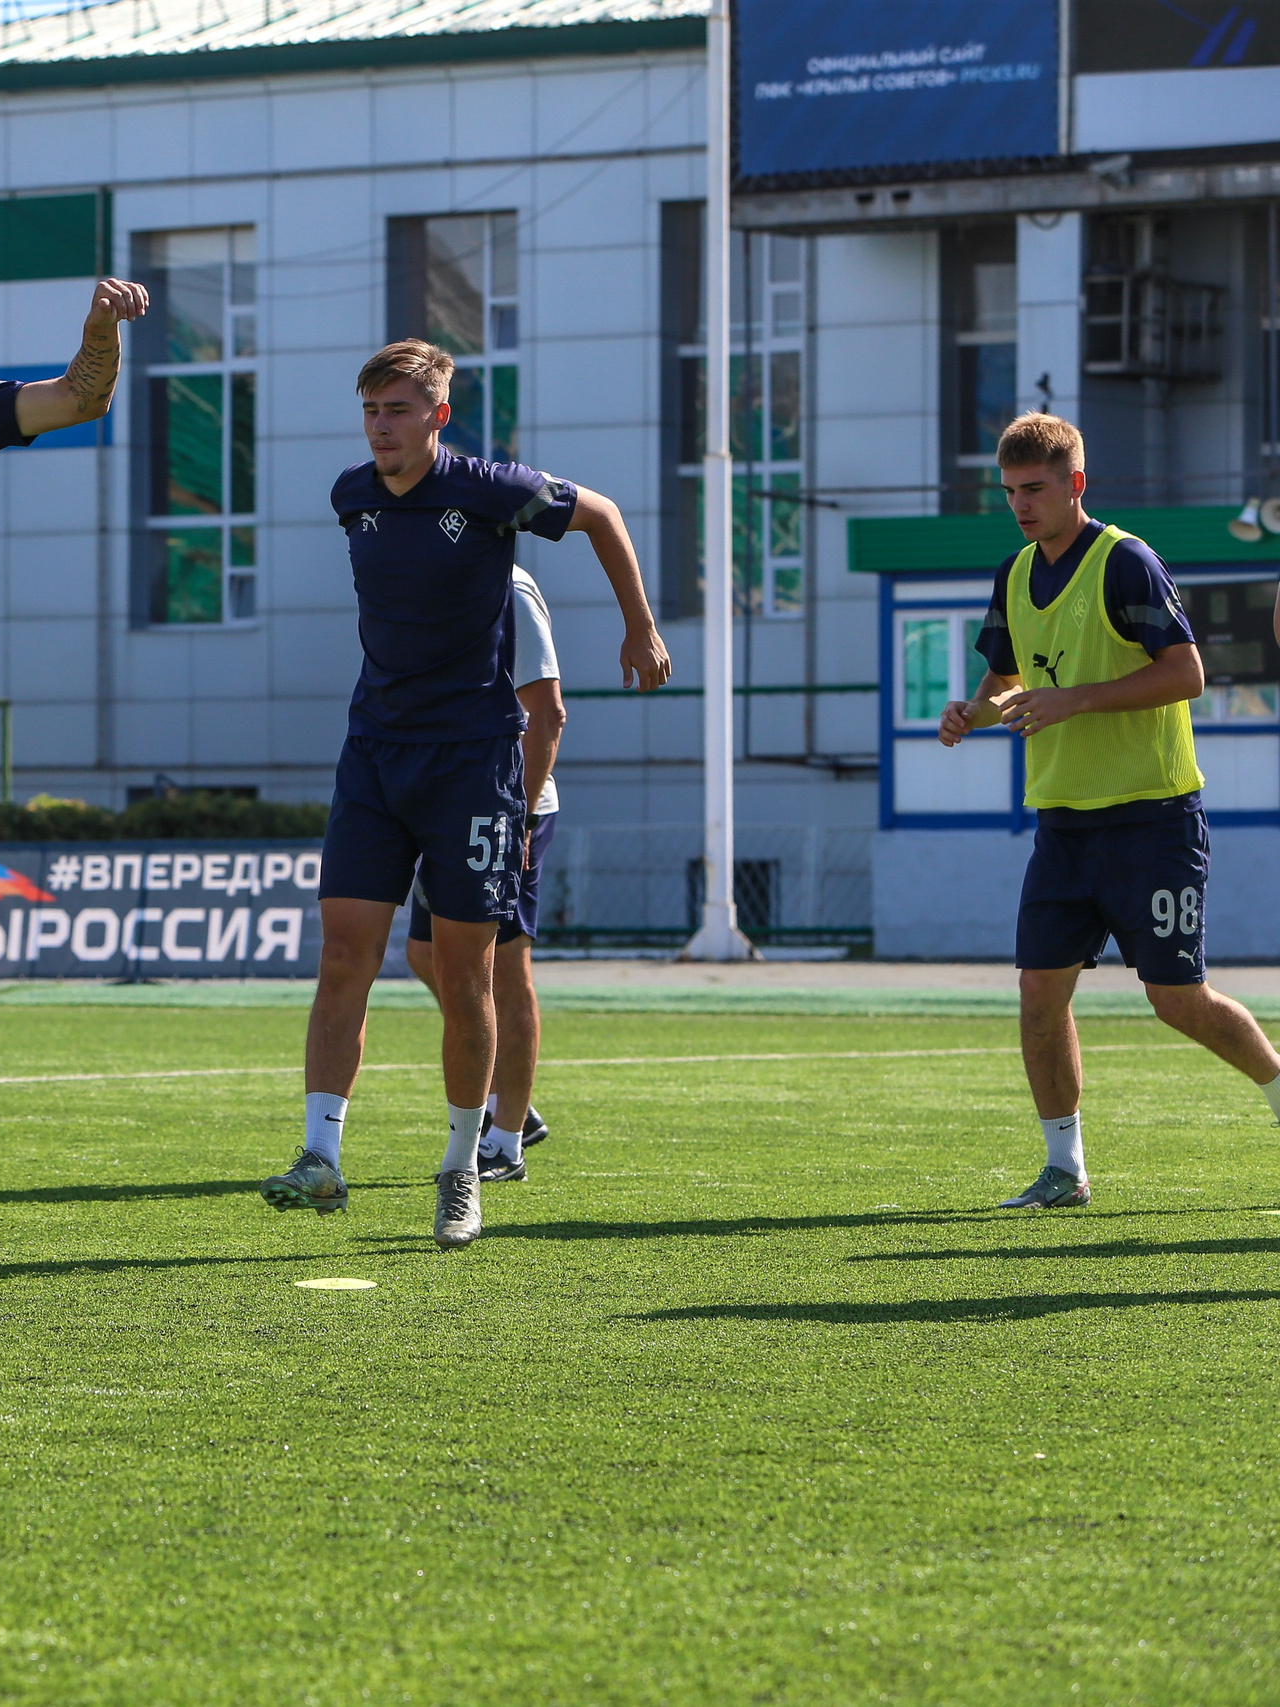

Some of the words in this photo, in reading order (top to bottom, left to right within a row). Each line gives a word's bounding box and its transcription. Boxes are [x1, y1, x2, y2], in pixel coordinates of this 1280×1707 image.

[939, 41, 986, 64] САЙТ
[466, 816, 507, 872] 51
[1151, 886, 1200, 939] 98
